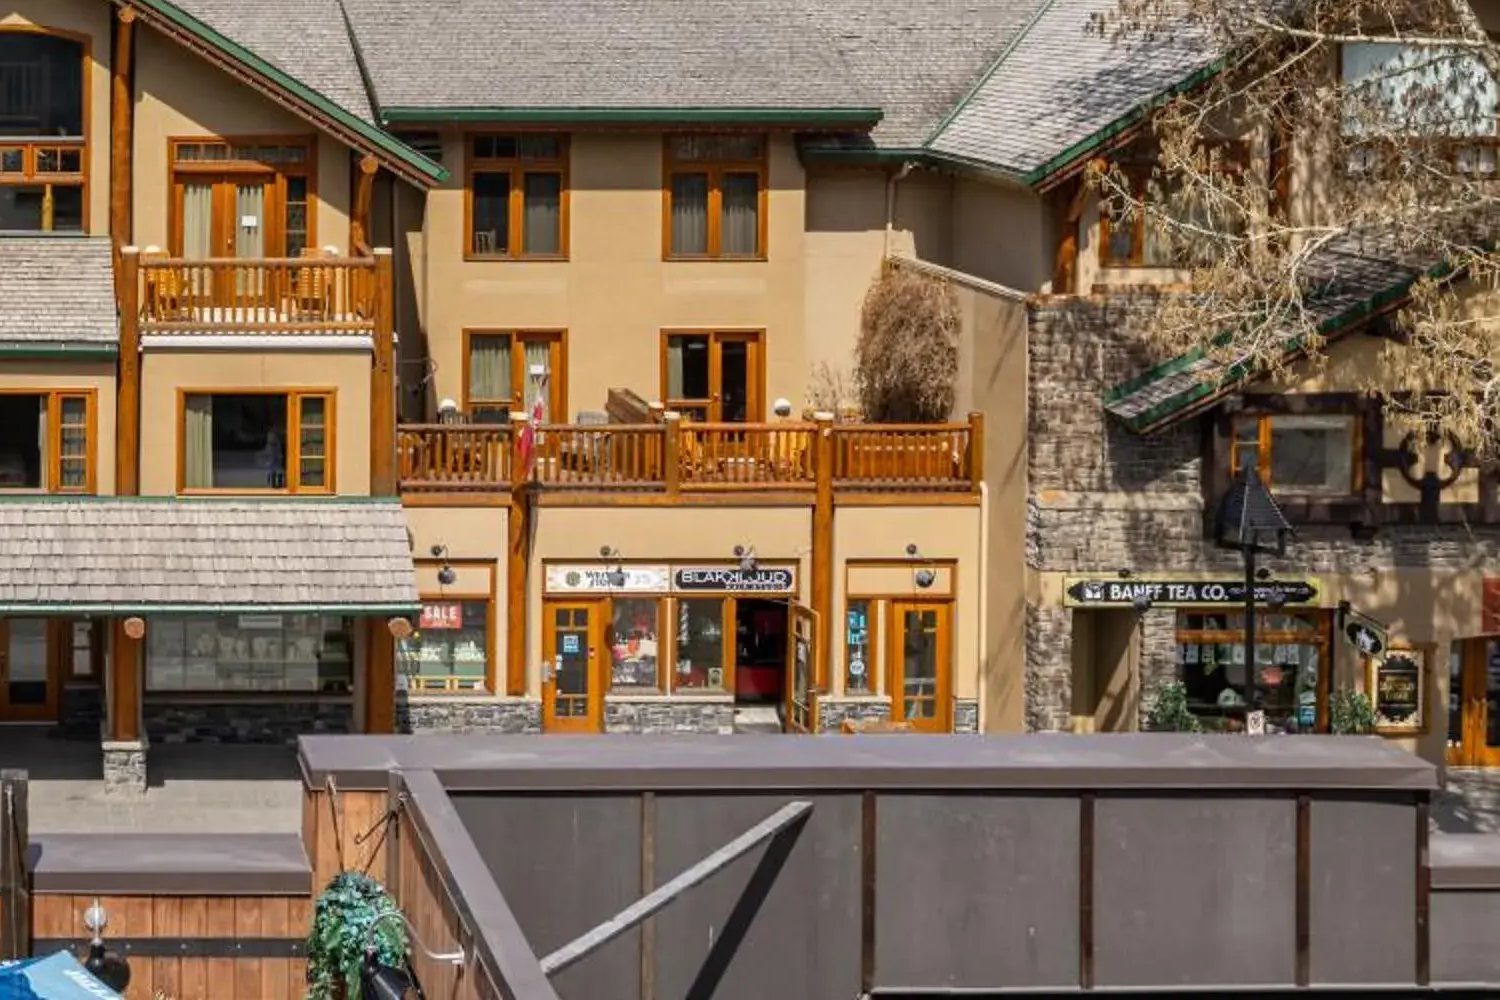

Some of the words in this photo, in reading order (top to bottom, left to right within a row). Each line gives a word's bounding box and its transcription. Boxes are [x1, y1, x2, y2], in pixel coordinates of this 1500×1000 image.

[1110, 584, 1163, 600] BANFF
[1167, 584, 1197, 600] TEA
[1201, 584, 1229, 600] CO.
[423, 605, 458, 620] SALE
